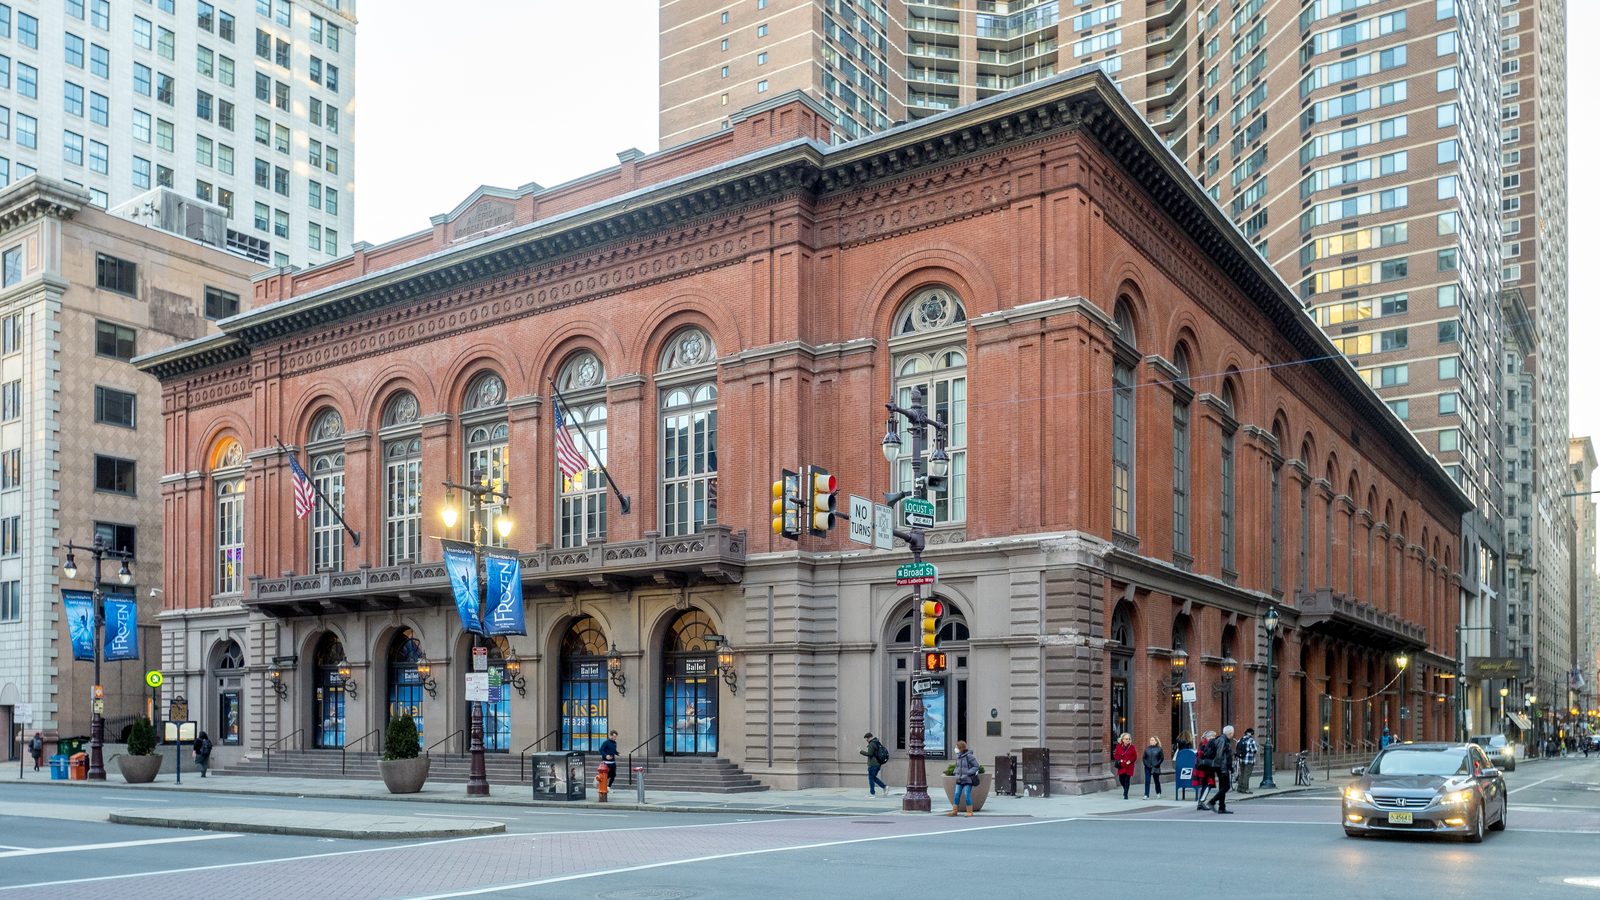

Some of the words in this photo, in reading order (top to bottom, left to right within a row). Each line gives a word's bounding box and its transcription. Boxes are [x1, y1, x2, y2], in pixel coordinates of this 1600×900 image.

[855, 504, 868, 520] NO
[905, 503, 927, 513] LOCUST
[851, 521, 871, 538] TURNS
[903, 568, 924, 577] Broad
[925, 567, 933, 575] St
[494, 562, 516, 622] FROZEN
[112, 603, 130, 650] FROZEN
[581, 667, 599, 675] Ballet
[686, 663, 706, 671] Ballet
